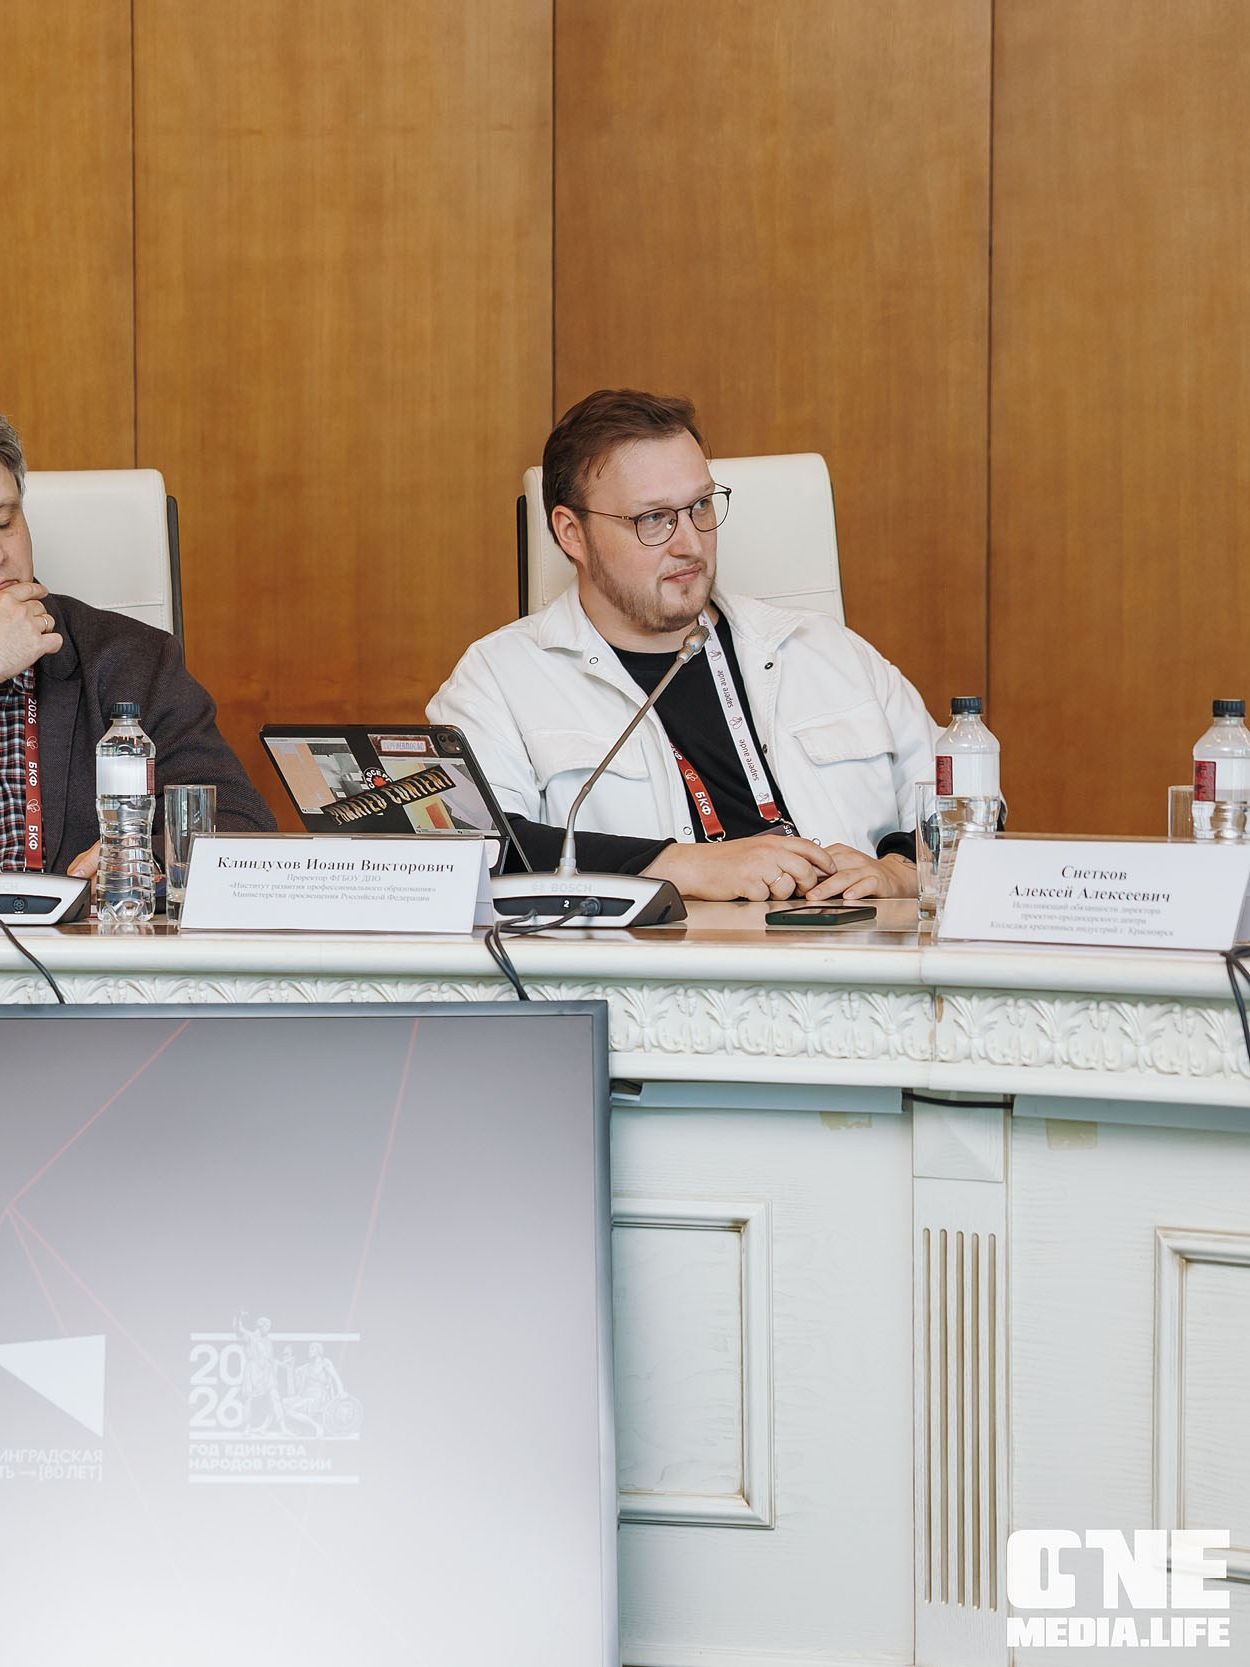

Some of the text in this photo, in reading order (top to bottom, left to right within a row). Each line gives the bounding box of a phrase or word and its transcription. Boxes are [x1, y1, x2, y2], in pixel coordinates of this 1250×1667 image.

[718, 670, 734, 708] sapere aude
[27, 697, 37, 724] 2026
[739, 739, 759, 781] sapere aude
[28, 761, 37, 787] БКФ
[695, 791, 712, 816] БКФ
[28, 824, 38, 850] БКФ
[217, 856, 454, 875] Клиндухов Иоанн Викторович
[1061, 865, 1127, 880] Снетков
[286, 873, 328, 882] Проректор
[329, 874, 359, 882] ФГБОУ
[550, 883, 592, 892] BOSCH
[563, 900, 570, 908] 2
[1009, 885, 1170, 902] Алексей Алексеевич
[189, 1343, 246, 1385] 20
[189, 1386, 244, 1428] 26
[189, 1444, 307, 1457] ГОД ЕДИНСТВА
[189, 1458, 333, 1472] НАРОДОВ РОССИИ
